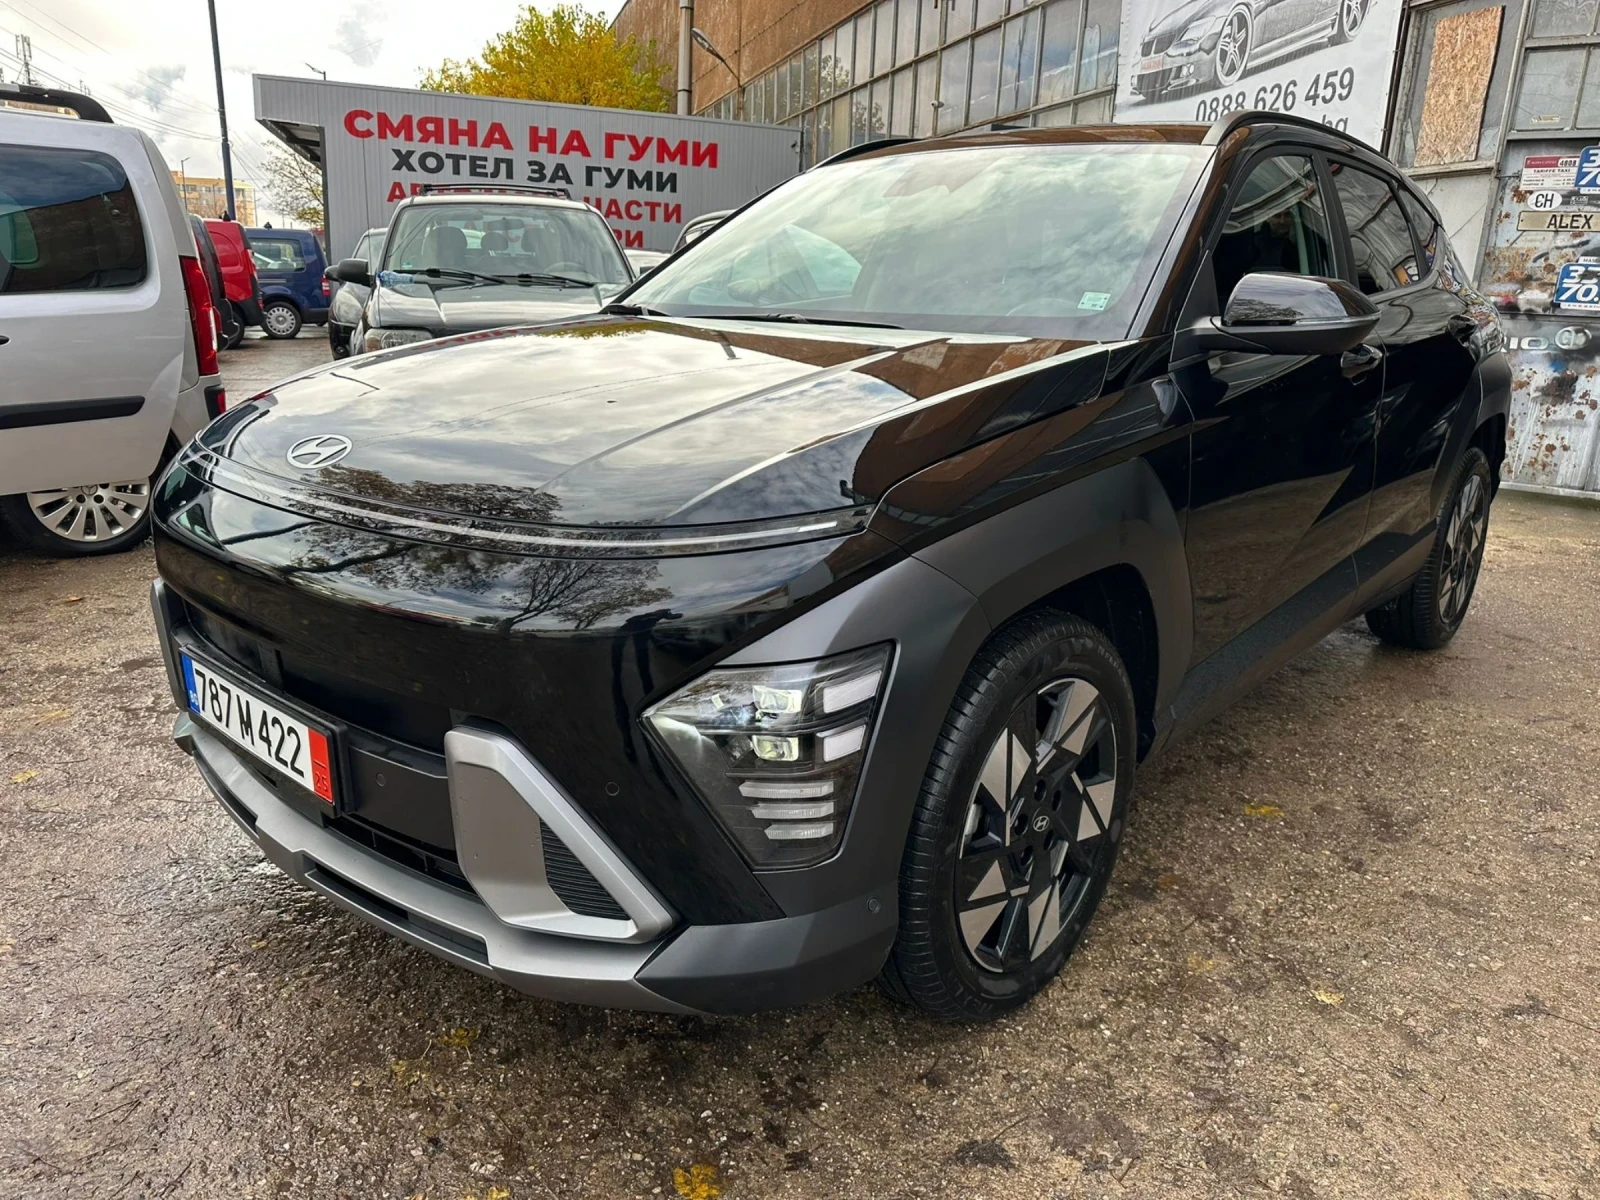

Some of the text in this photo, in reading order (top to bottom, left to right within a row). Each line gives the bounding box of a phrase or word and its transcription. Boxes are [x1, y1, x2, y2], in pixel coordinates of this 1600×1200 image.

[1254, 80, 1297, 112] 626
[1304, 66, 1355, 107] 459
[343, 109, 719, 169] СМЯНА НА ГУМИ
[392, 148, 514, 180] ХОТЕЛ
[527, 160, 573, 185] ЗА
[585, 165, 678, 193] ГУМИ
[1534, 193, 1555, 209] CH
[1546, 214, 1594, 230] ALEX
[194, 667, 232, 729] 787
[258, 709, 305, 778] 422
